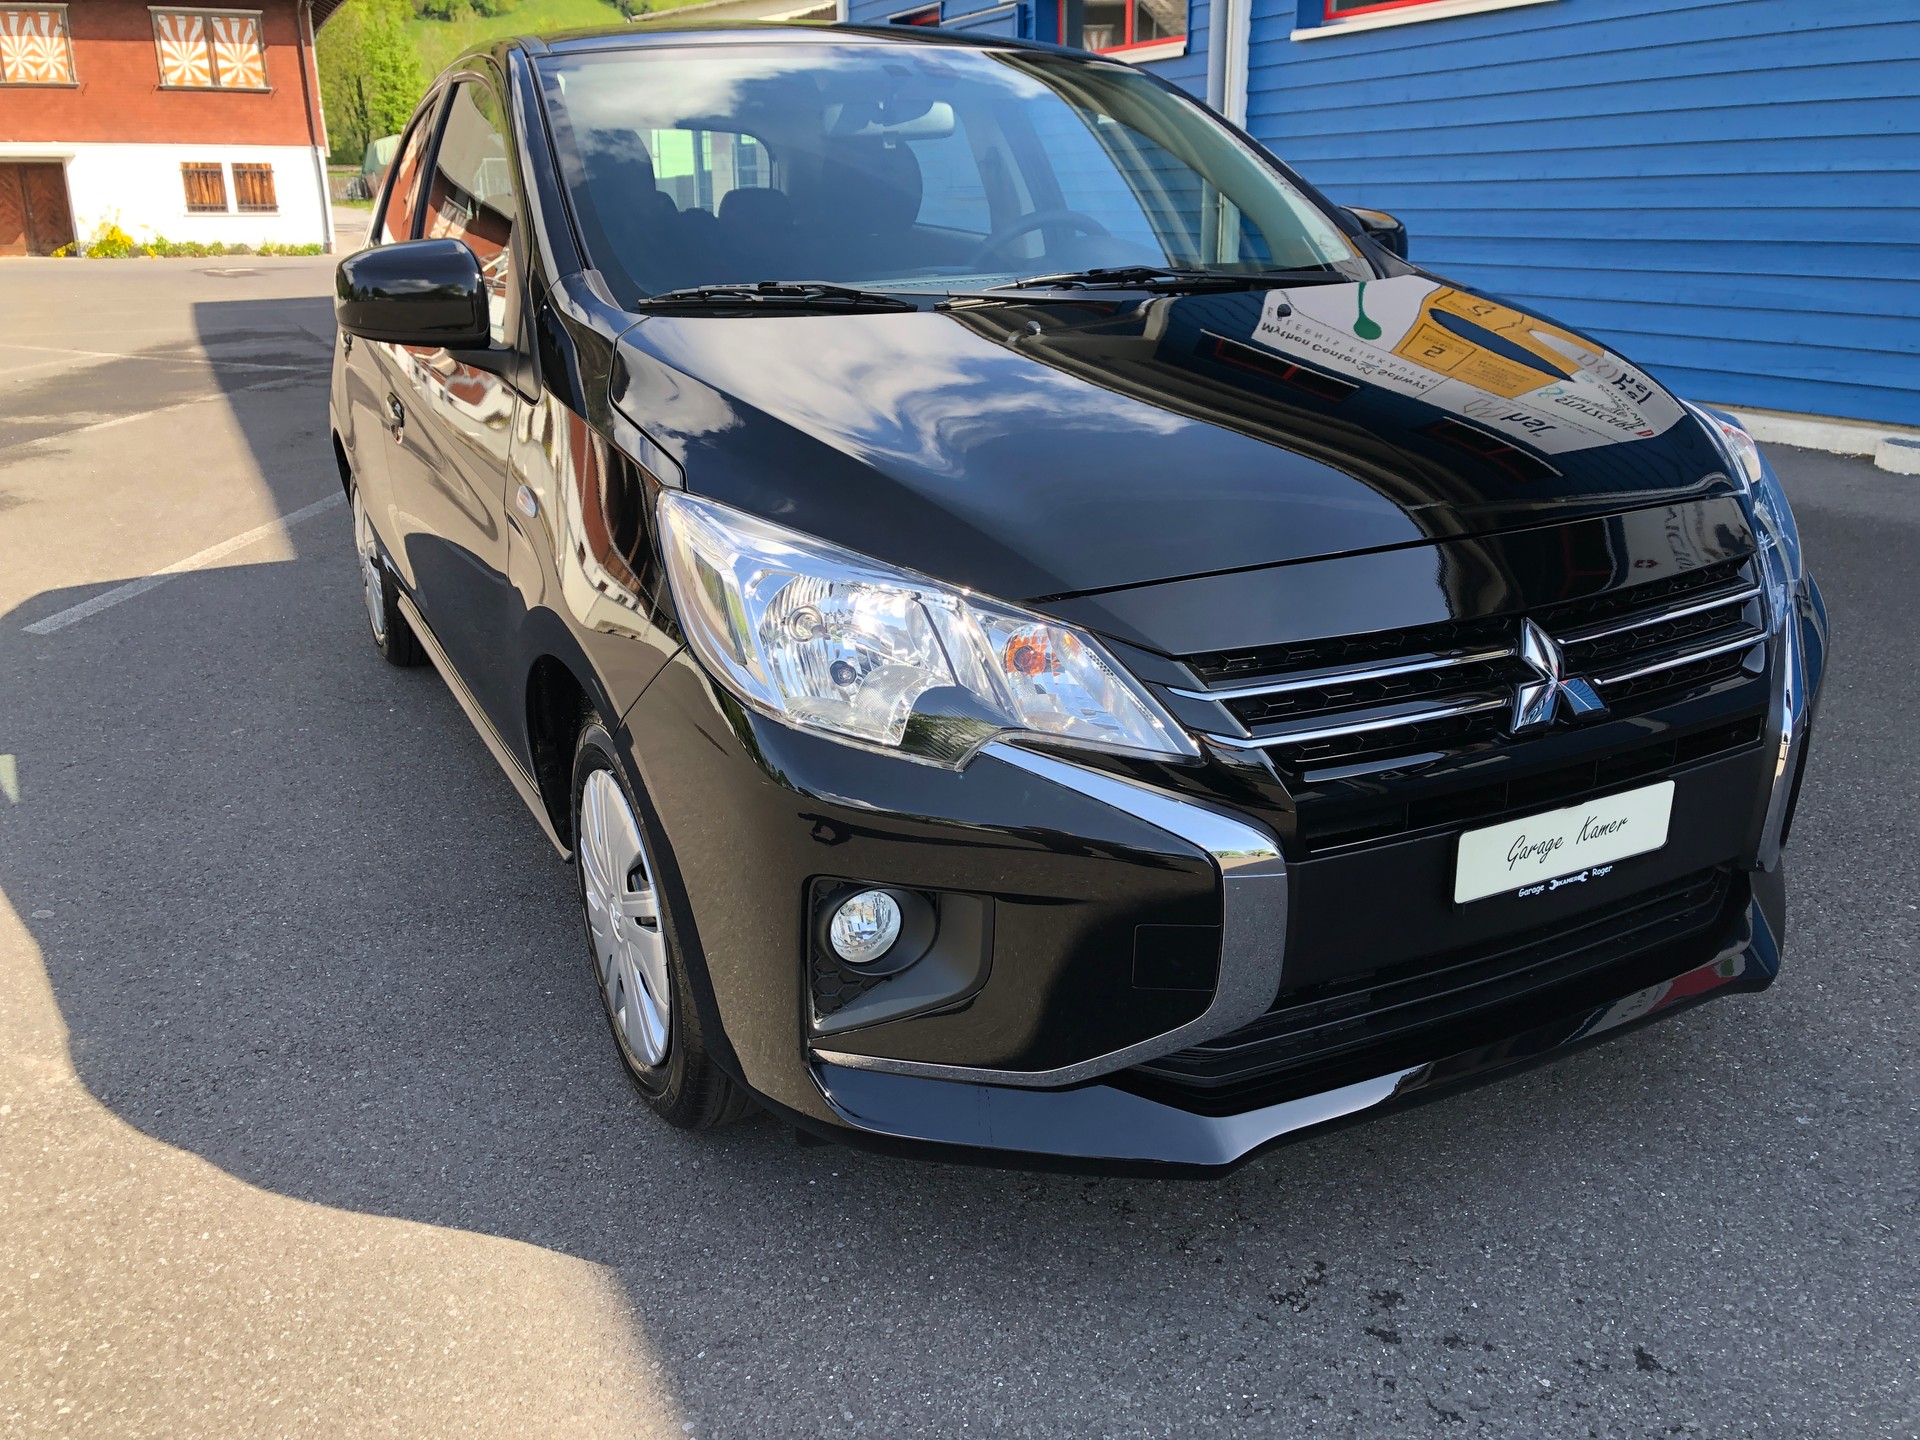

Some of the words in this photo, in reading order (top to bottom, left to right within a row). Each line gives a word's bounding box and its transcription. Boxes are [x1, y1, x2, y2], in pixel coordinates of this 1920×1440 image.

[1507, 835, 1564, 871] Garage
[1576, 816, 1628, 845] Kamer
[1518, 885, 1545, 897] Garage
[1592, 865, 1613, 877] Roger
